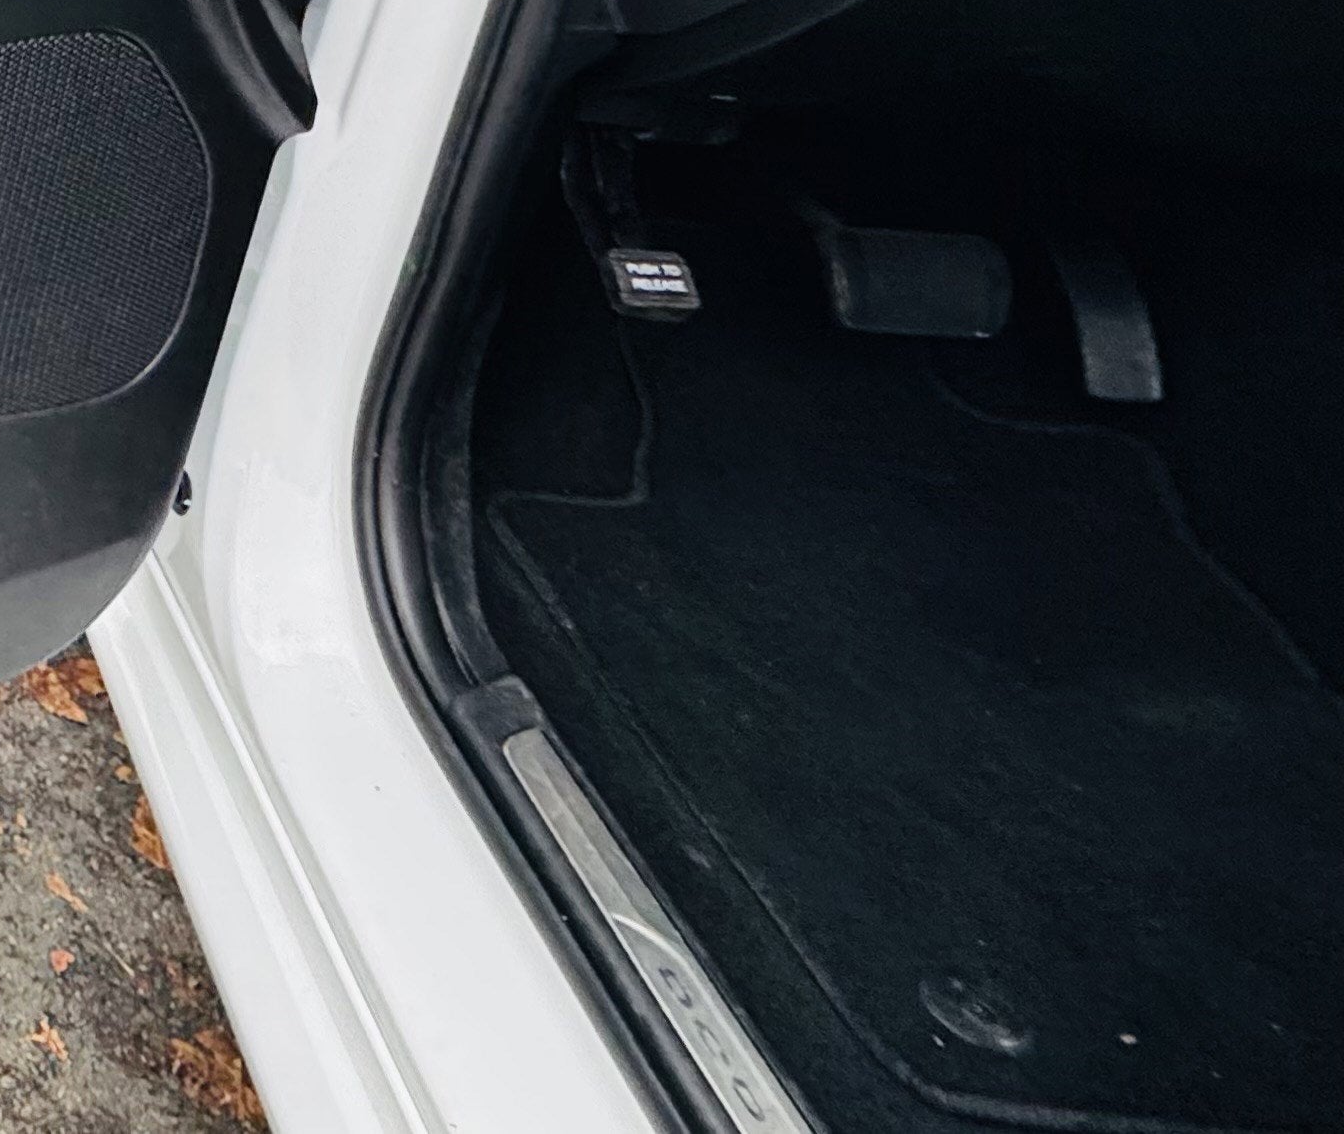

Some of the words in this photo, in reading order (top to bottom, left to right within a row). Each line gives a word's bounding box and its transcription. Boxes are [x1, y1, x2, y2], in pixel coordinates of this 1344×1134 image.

[625, 262, 660, 276] PUSH
[660, 264, 683, 277] TO
[631, 277, 689, 294] RELEASE
